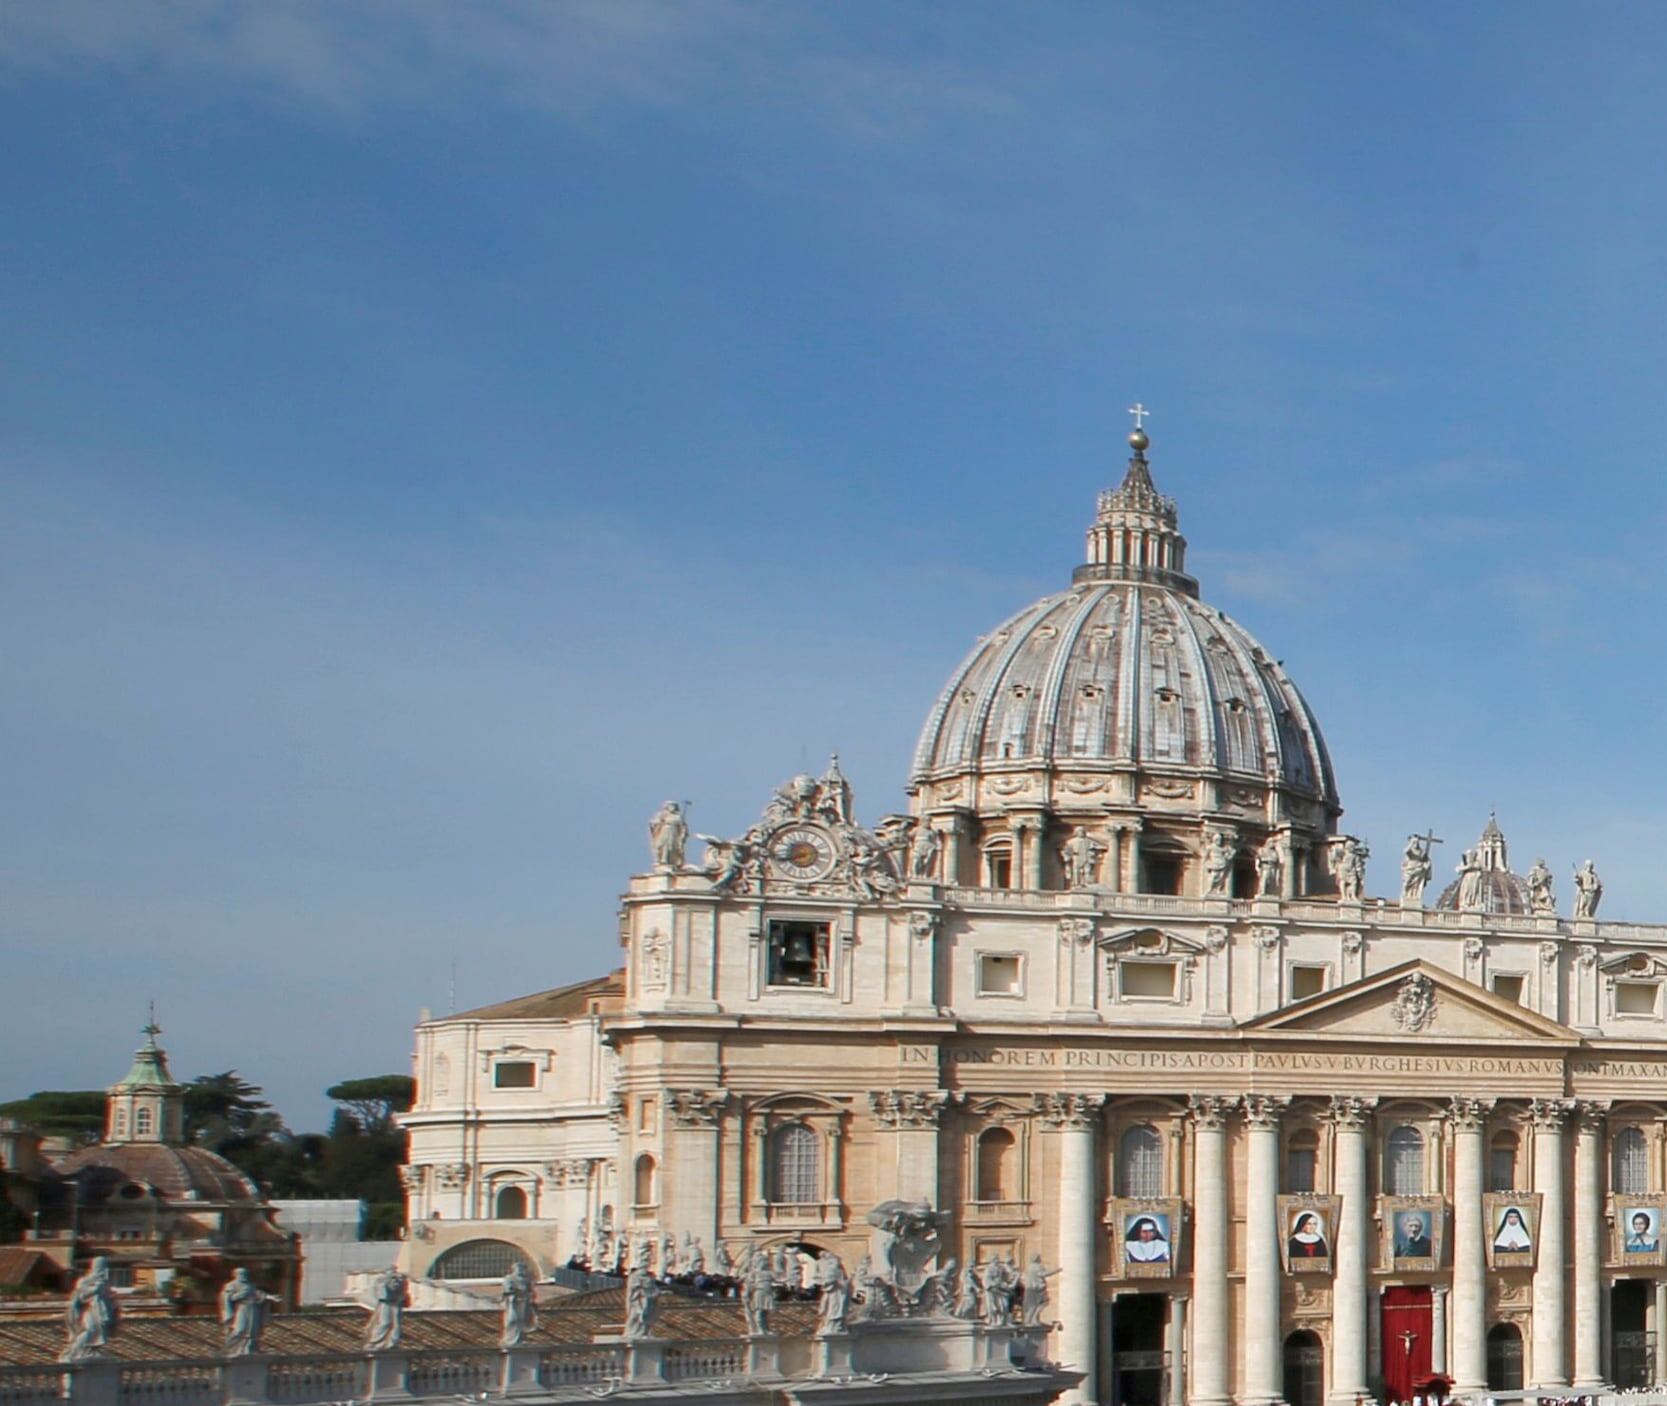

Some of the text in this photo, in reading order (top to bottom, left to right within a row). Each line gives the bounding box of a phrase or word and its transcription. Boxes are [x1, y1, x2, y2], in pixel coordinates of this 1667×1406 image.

[902, 1047, 928, 1062] IN
[1066, 1050, 1178, 1068] PRINCIPIS
[1181, 1053, 1249, 1068] APOST
[1254, 1054, 1321, 1069] PAVLVS
[1343, 1056, 1463, 1072] BVRGHESIVS
[1469, 1059, 1563, 1074] ROMANVS
[1611, 1063, 1648, 1077] MAX
